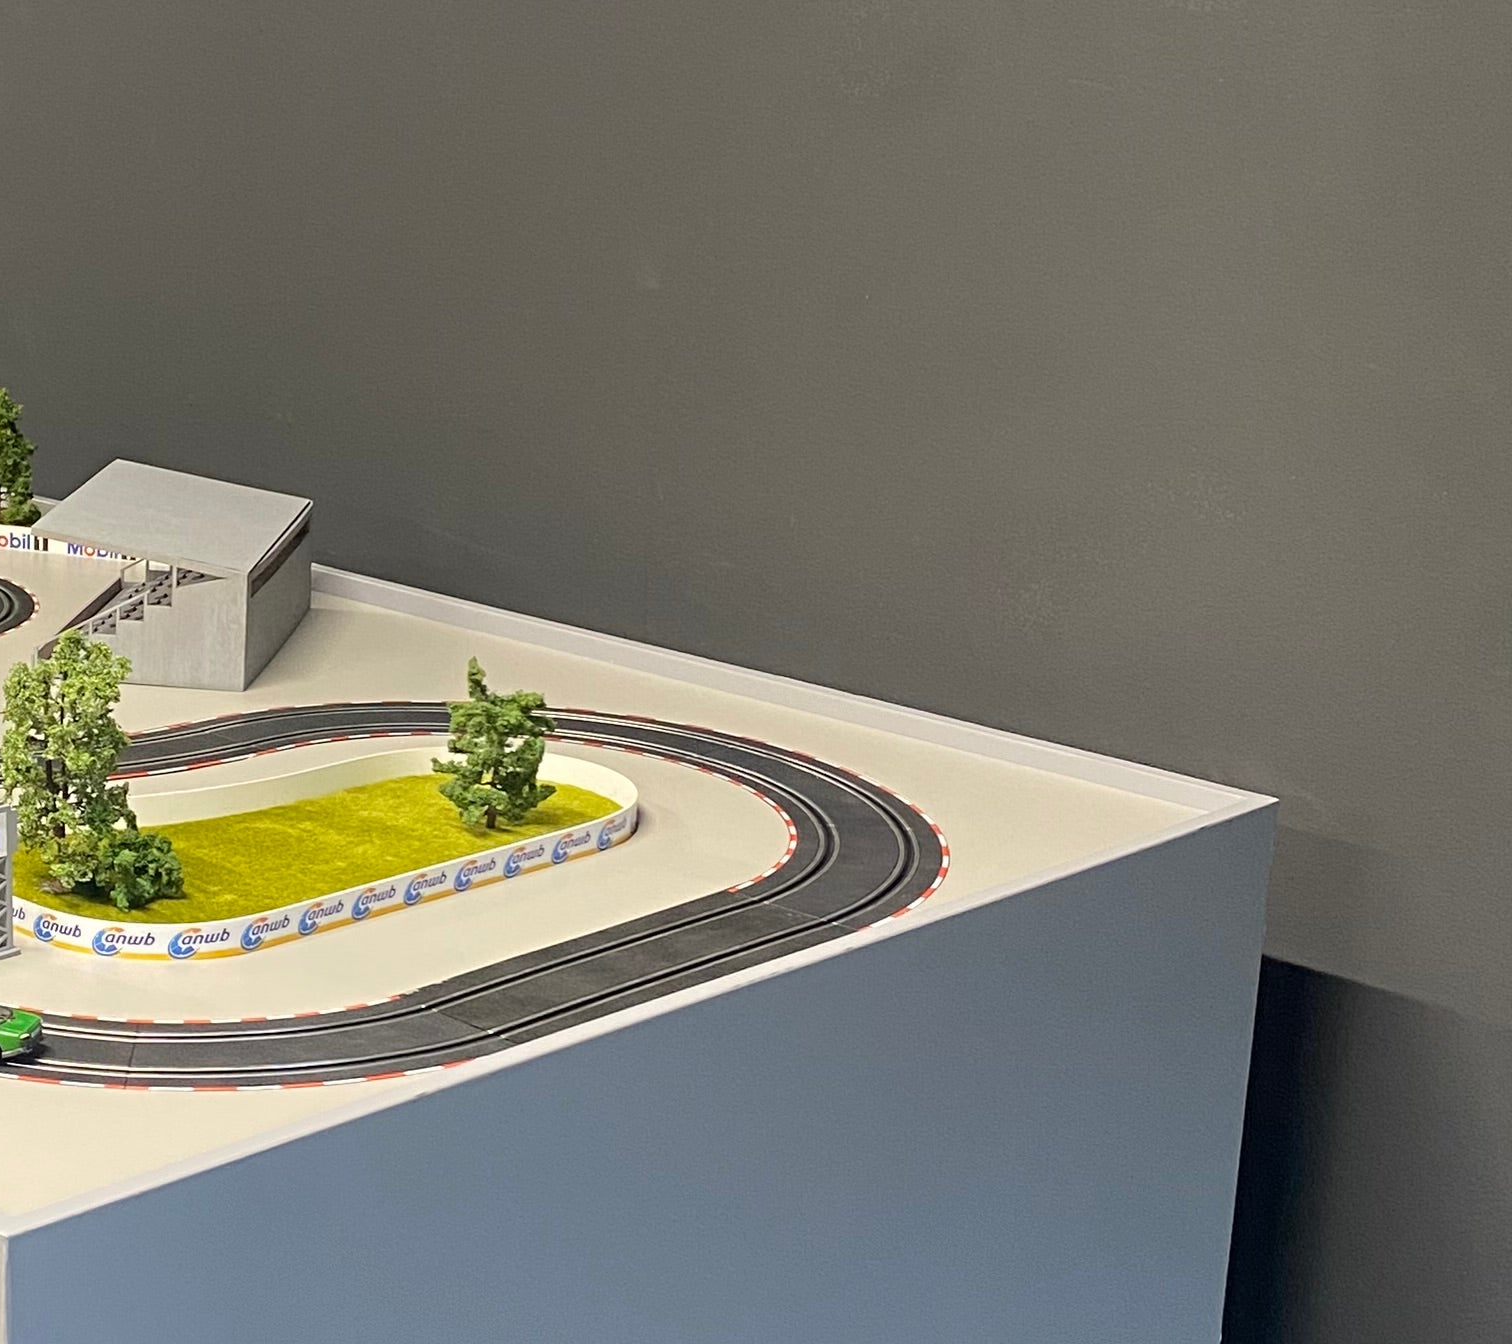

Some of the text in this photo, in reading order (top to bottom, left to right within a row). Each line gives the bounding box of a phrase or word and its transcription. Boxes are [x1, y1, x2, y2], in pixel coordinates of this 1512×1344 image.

[463, 857, 496, 878] anwb
[413, 870, 447, 891] anwb
[361, 885, 396, 906] anwb
[308, 900, 344, 921] anwb
[41, 918, 82, 938] anwb
[105, 928, 155, 946] anwb
[182, 928, 230, 946] anwb
[252, 916, 290, 937] anwb
